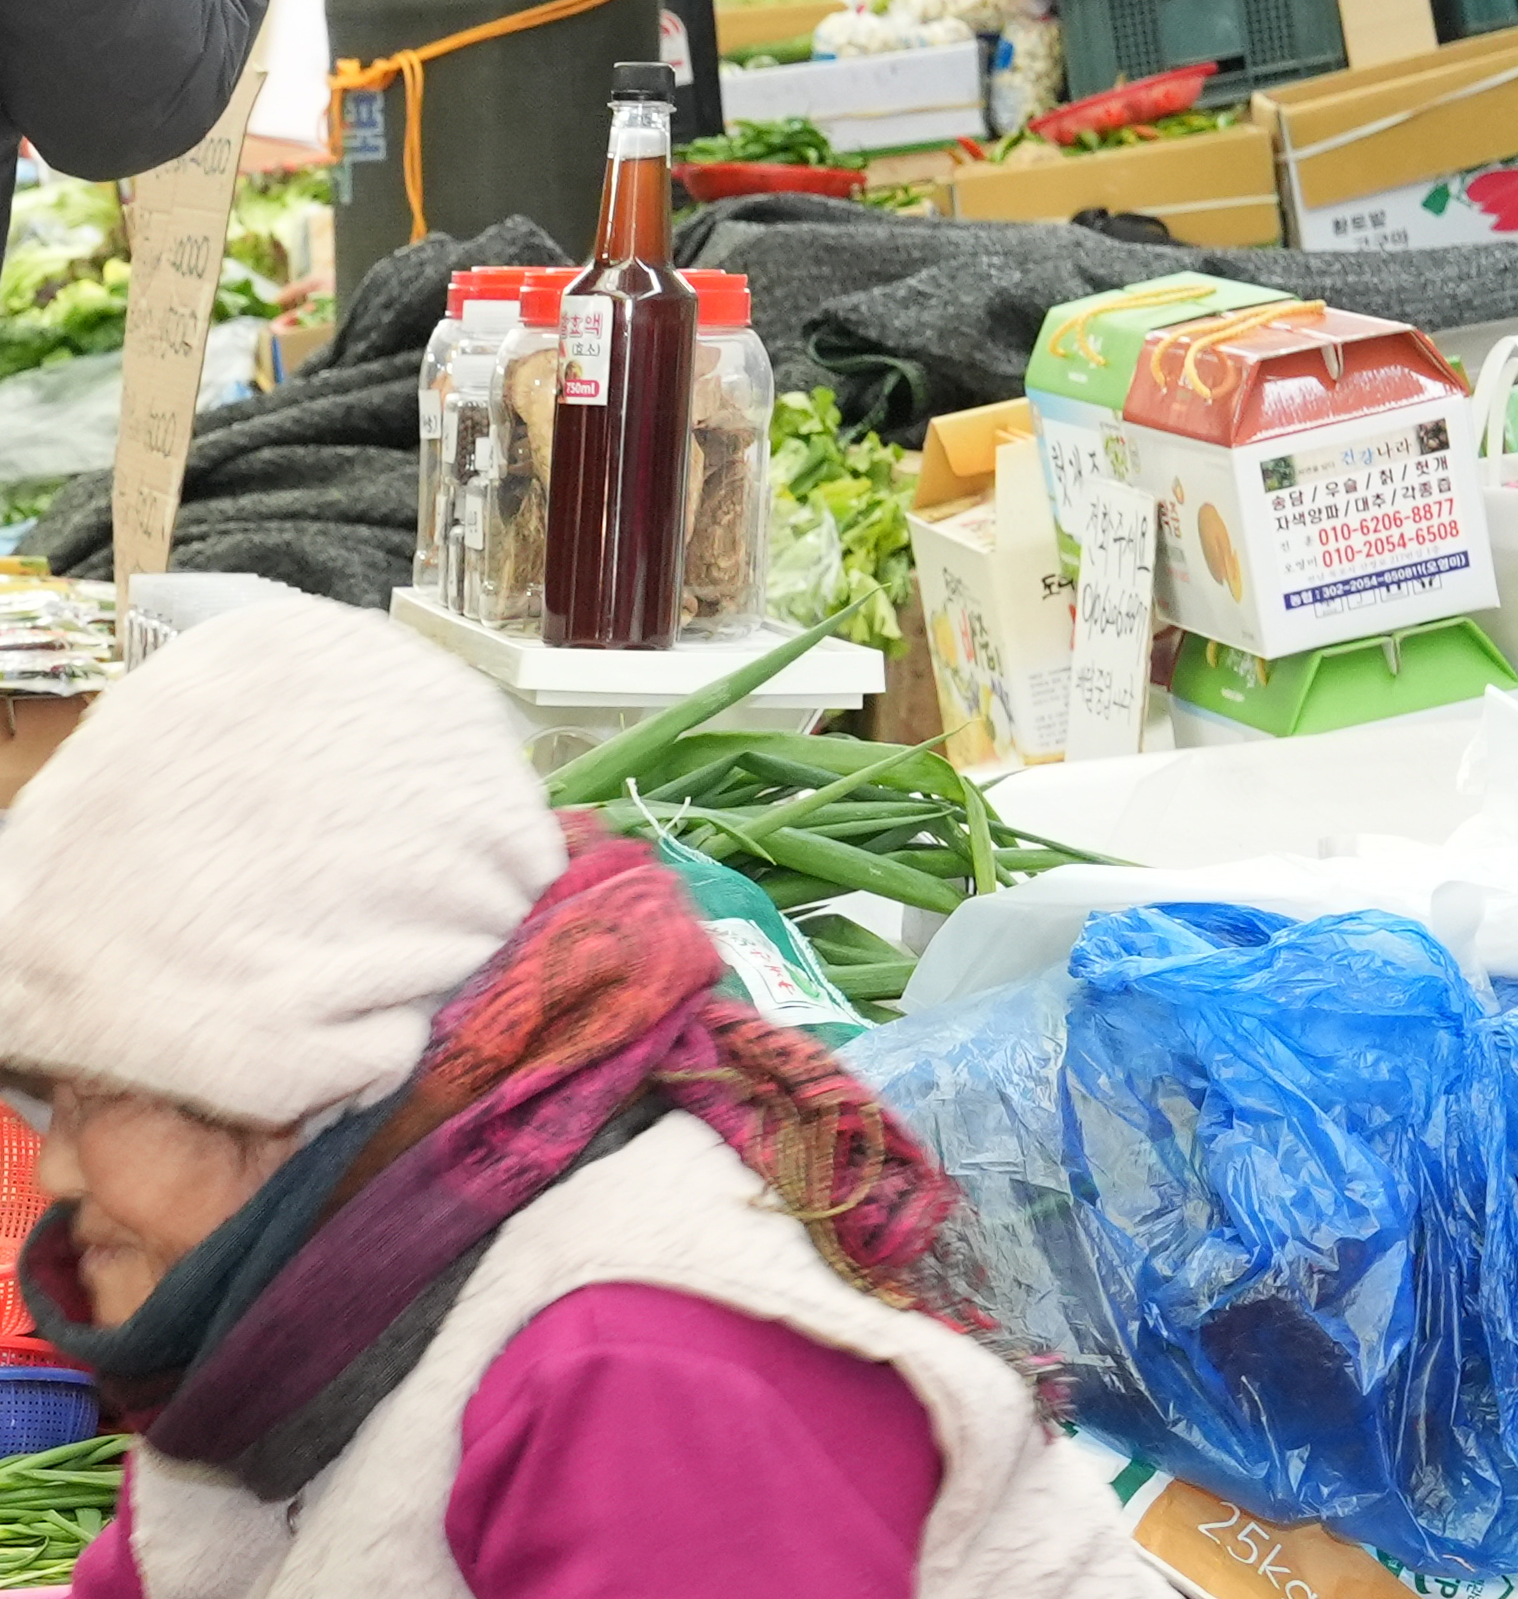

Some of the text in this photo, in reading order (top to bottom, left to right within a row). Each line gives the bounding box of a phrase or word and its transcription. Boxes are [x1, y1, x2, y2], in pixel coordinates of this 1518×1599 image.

[566, 381, 596, 395] 750ml
[1415, 455, 1449, 477] 헛개
[1318, 498, 1455, 547] 010-6206-8877
[1322, 520, 1461, 568] 010-2054-6508
